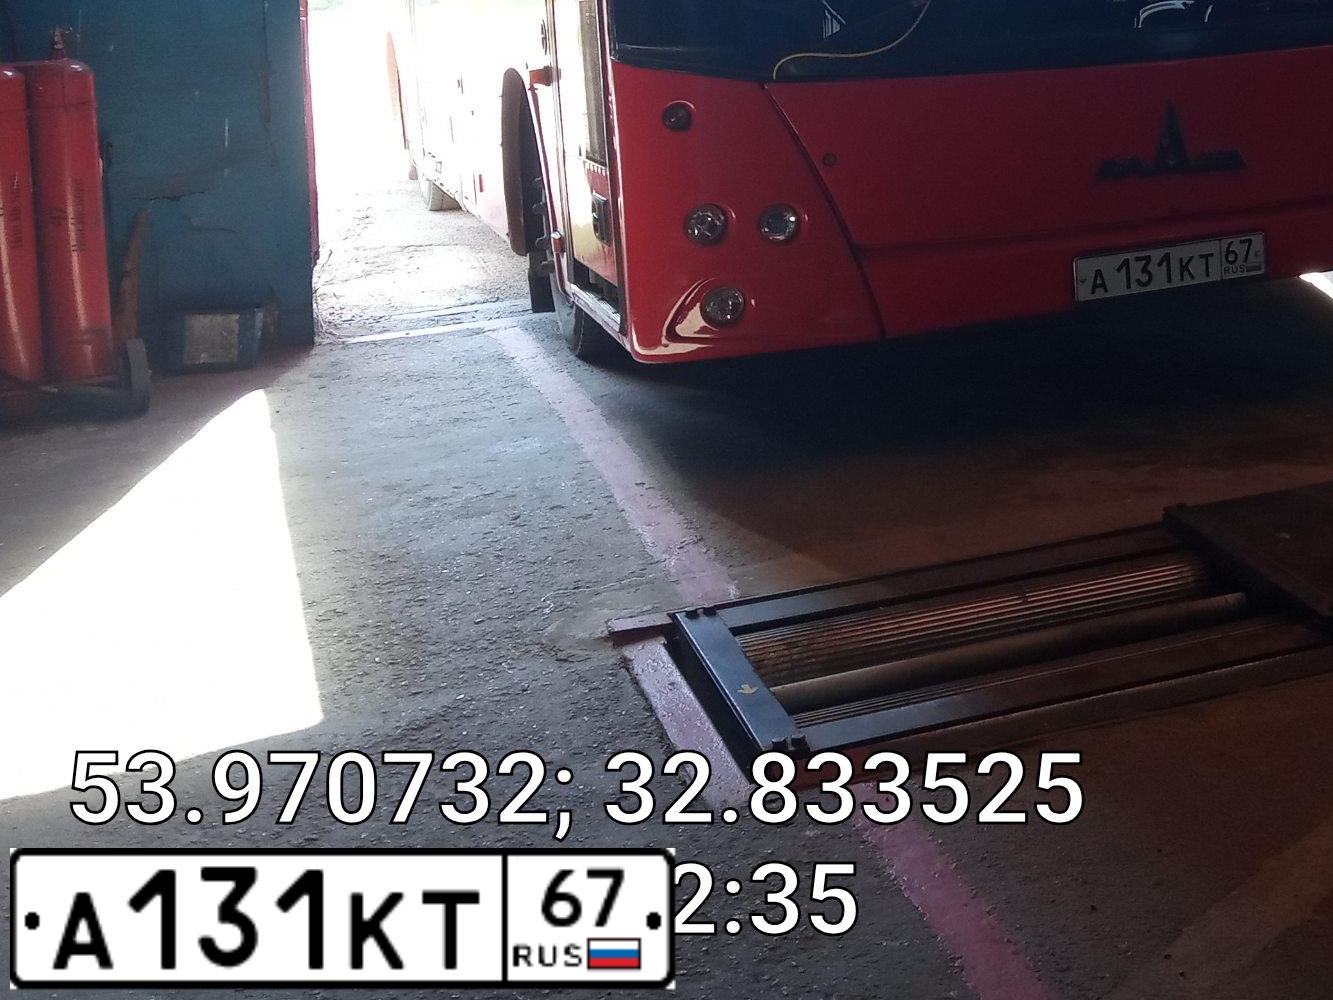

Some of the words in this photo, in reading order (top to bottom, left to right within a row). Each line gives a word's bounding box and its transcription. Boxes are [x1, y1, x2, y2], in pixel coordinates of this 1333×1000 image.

[1090, 251, 1214, 295] А131КТ
[1224, 238, 1253, 265] 67
[1223, 263, 1246, 275] RUS
